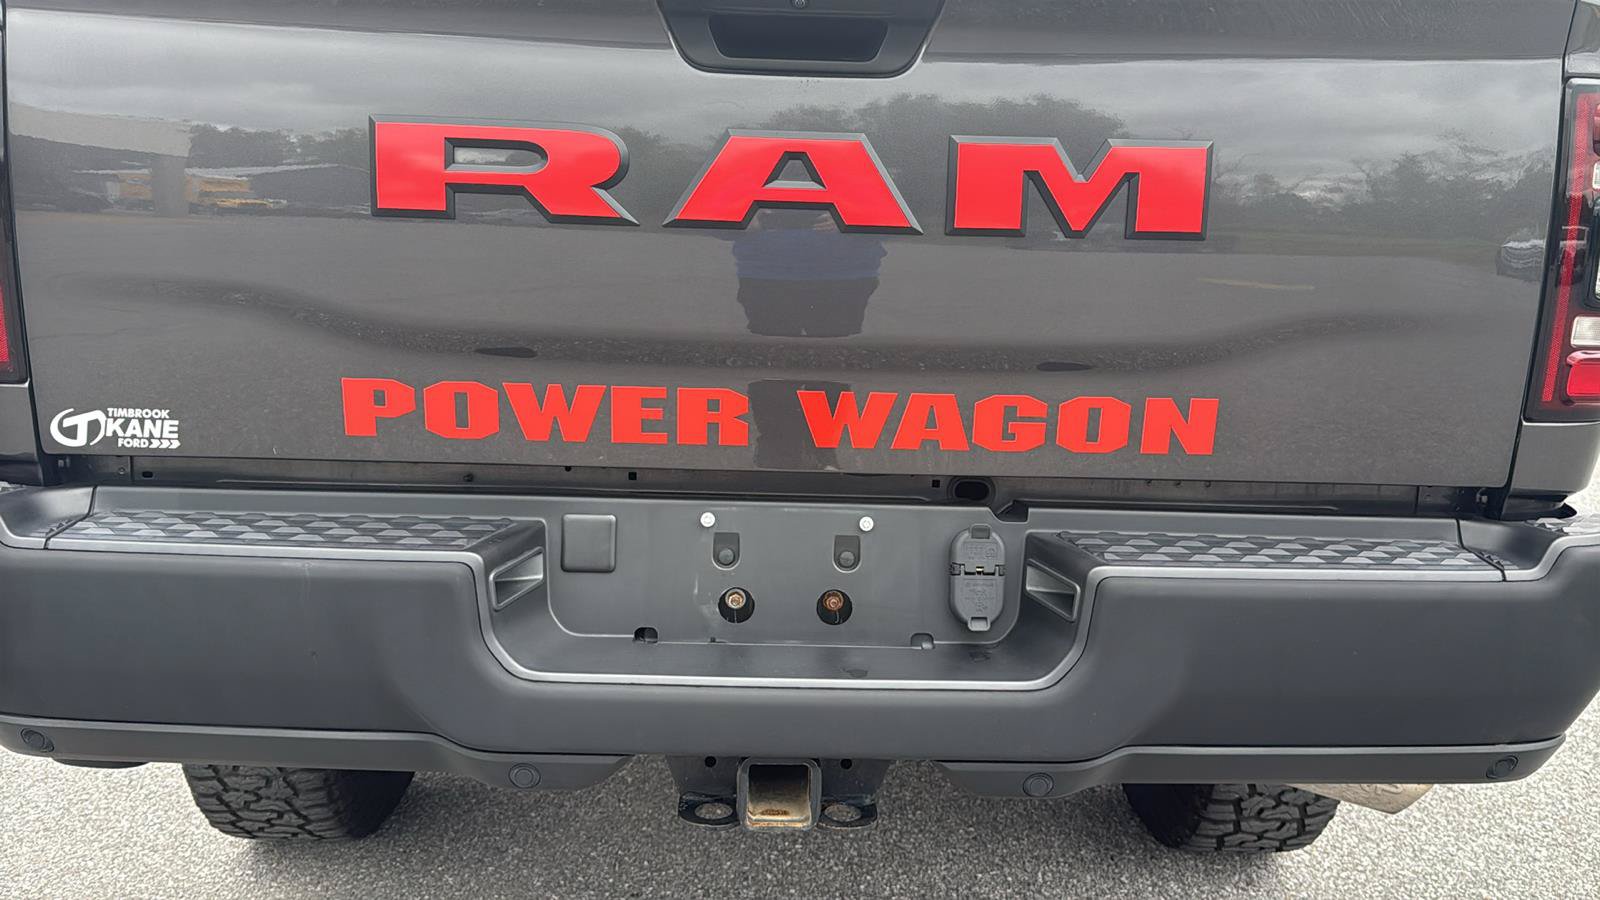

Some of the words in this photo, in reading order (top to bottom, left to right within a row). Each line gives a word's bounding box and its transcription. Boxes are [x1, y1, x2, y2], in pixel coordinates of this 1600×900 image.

[369, 115, 1213, 240] RAM
[107, 408, 170, 419] TIMBROOK
[342, 377, 750, 447] POWER
[796, 389, 1220, 456] WAGON
[105, 418, 179, 438] KANE
[118, 438, 149, 449] FORD
